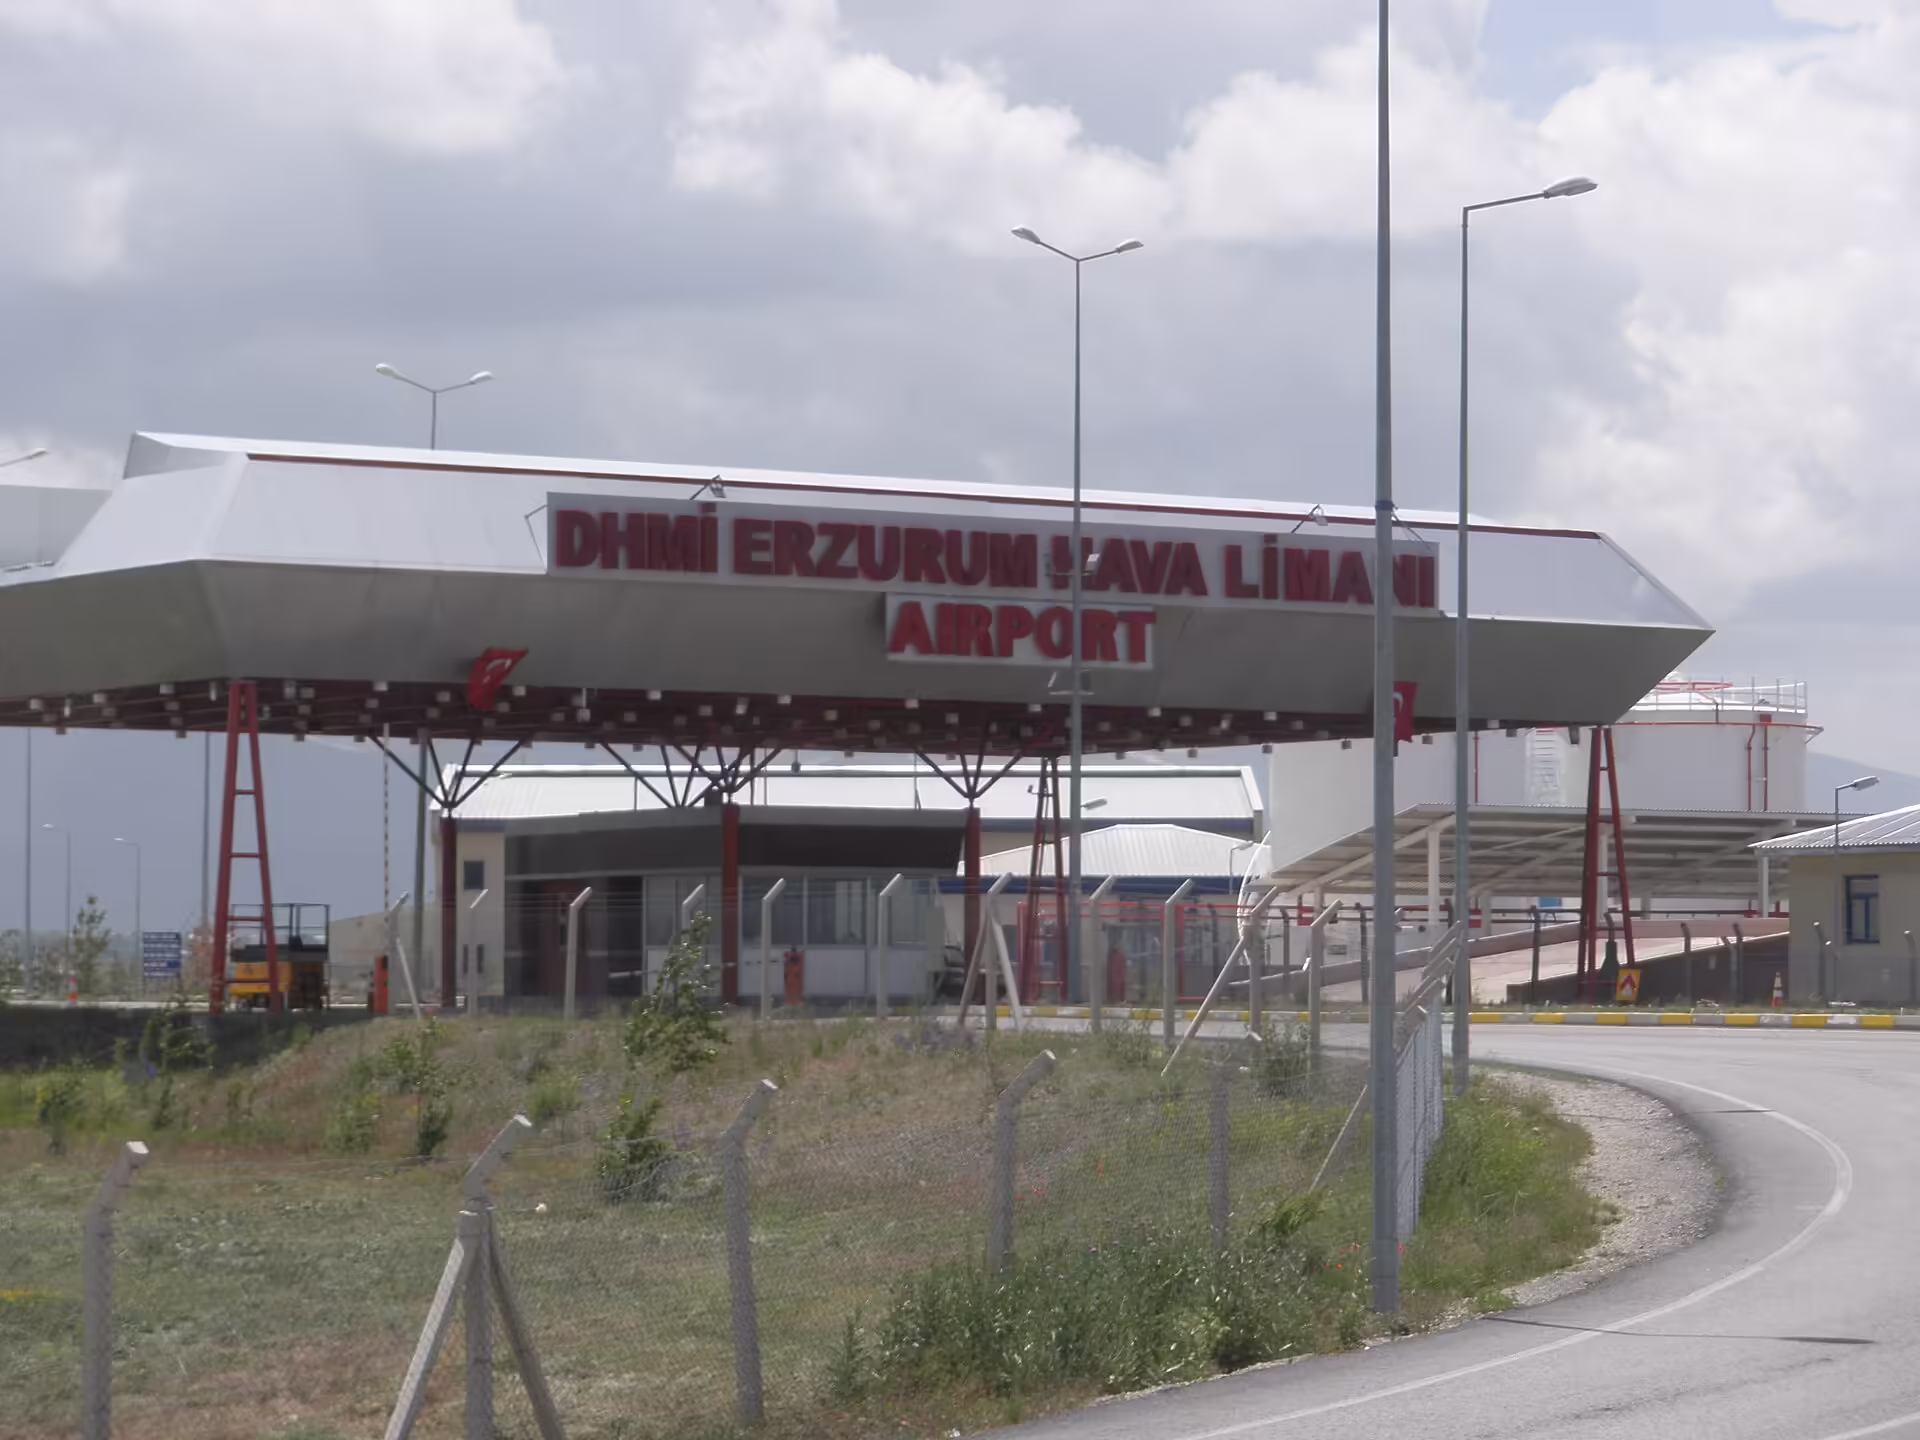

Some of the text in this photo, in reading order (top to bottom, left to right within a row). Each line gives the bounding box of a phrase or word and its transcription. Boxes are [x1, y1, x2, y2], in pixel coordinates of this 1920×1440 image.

[555, 502, 719, 573] DHMİ
[733, 517, 1038, 588] ERZURUM
[1050, 535, 1208, 597] HAVA
[888, 601, 1156, 663] AIRPORT
